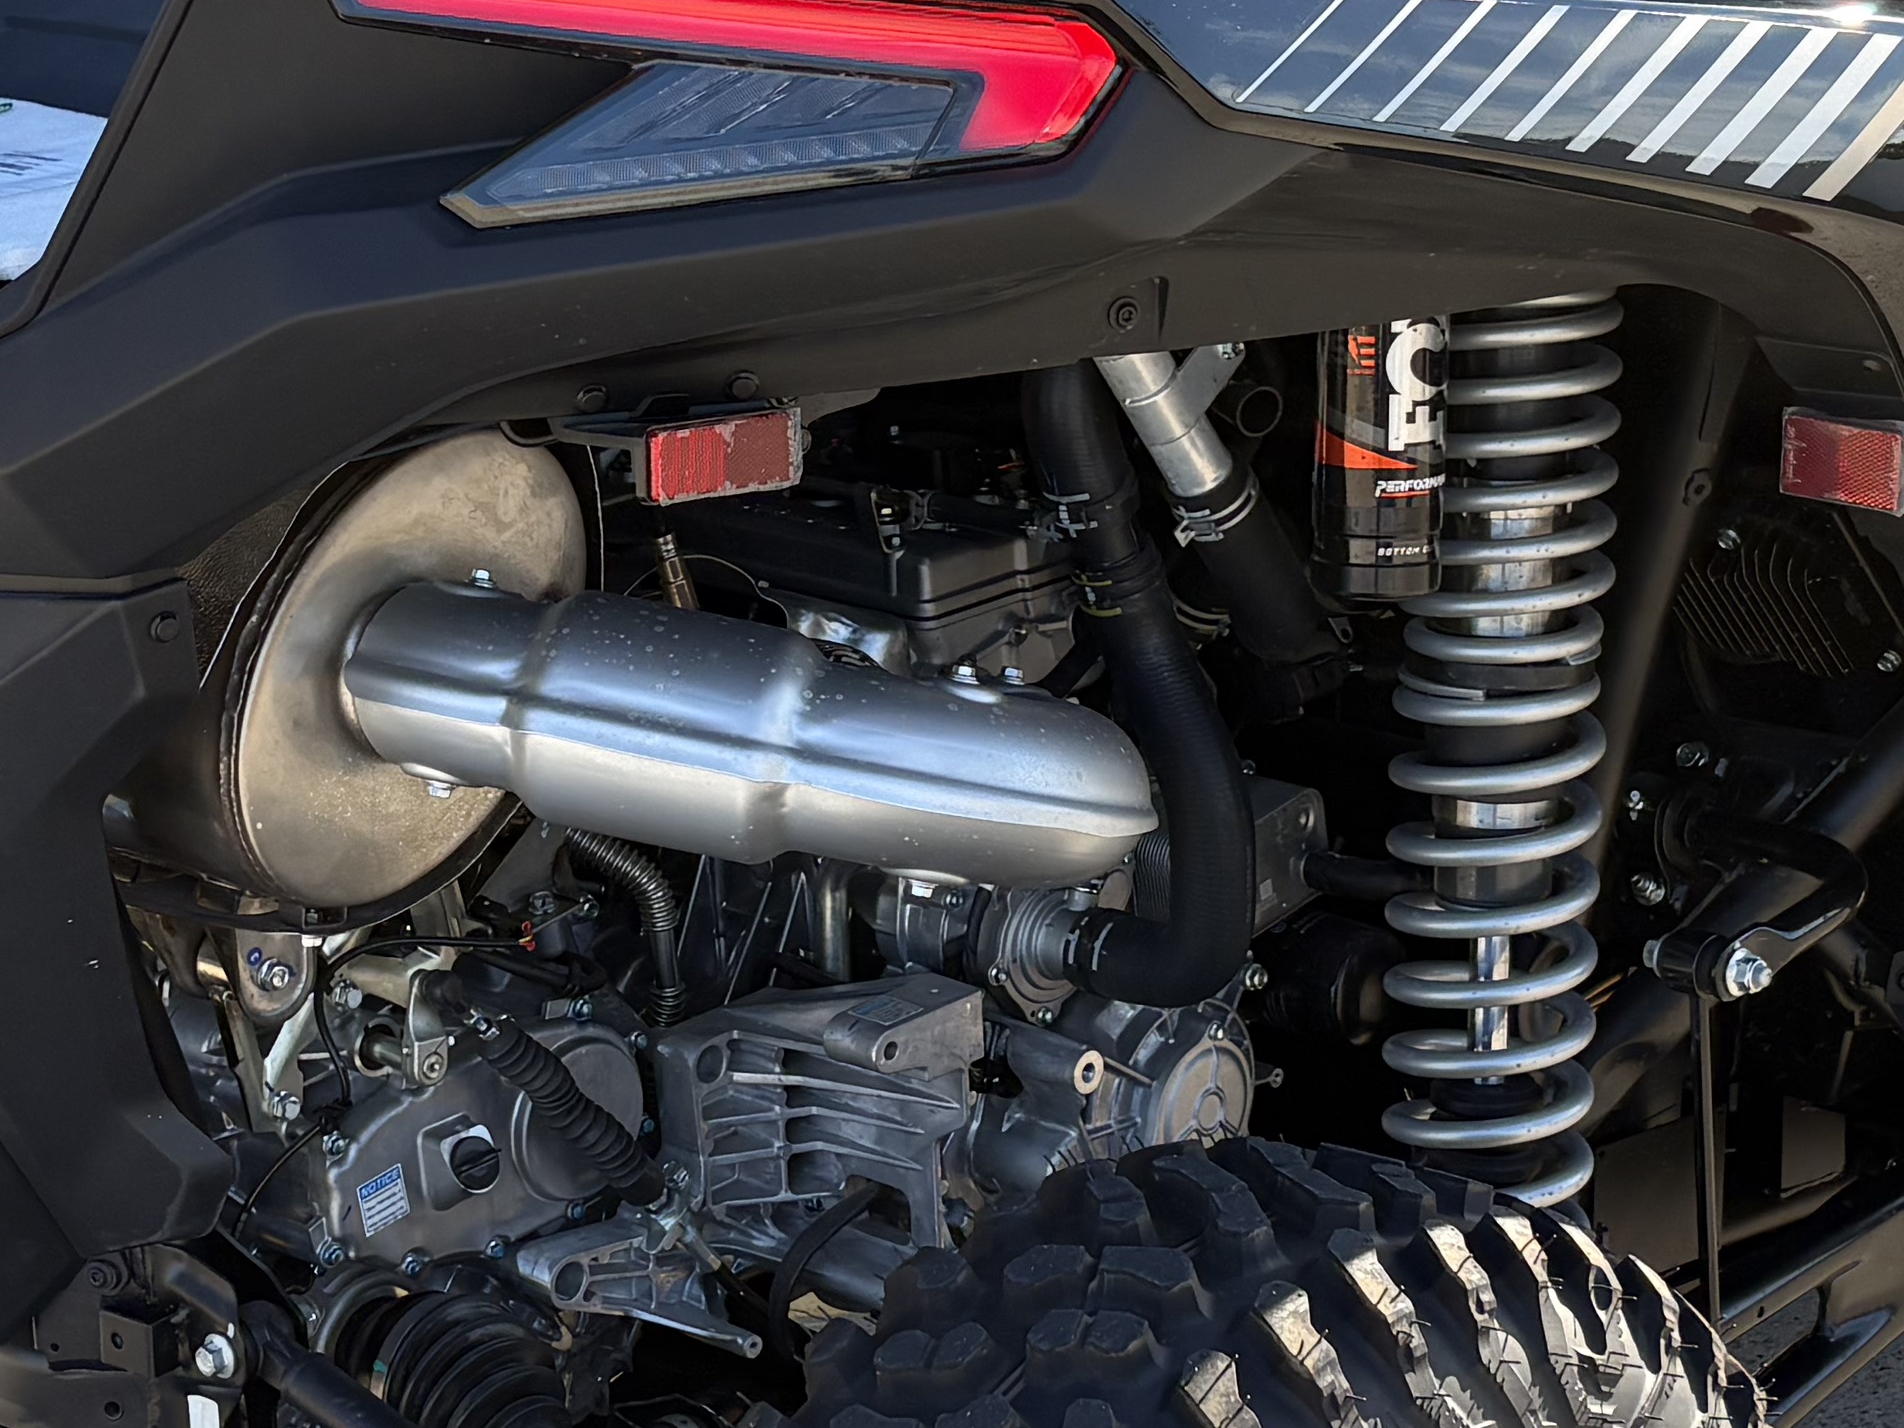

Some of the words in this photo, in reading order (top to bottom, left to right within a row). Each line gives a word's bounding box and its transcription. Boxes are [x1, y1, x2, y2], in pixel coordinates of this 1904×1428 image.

[1386, 316, 1448, 452] FO
[1375, 474, 1446, 498] PERFORM
[360, 1167, 400, 1198] NOTICE
